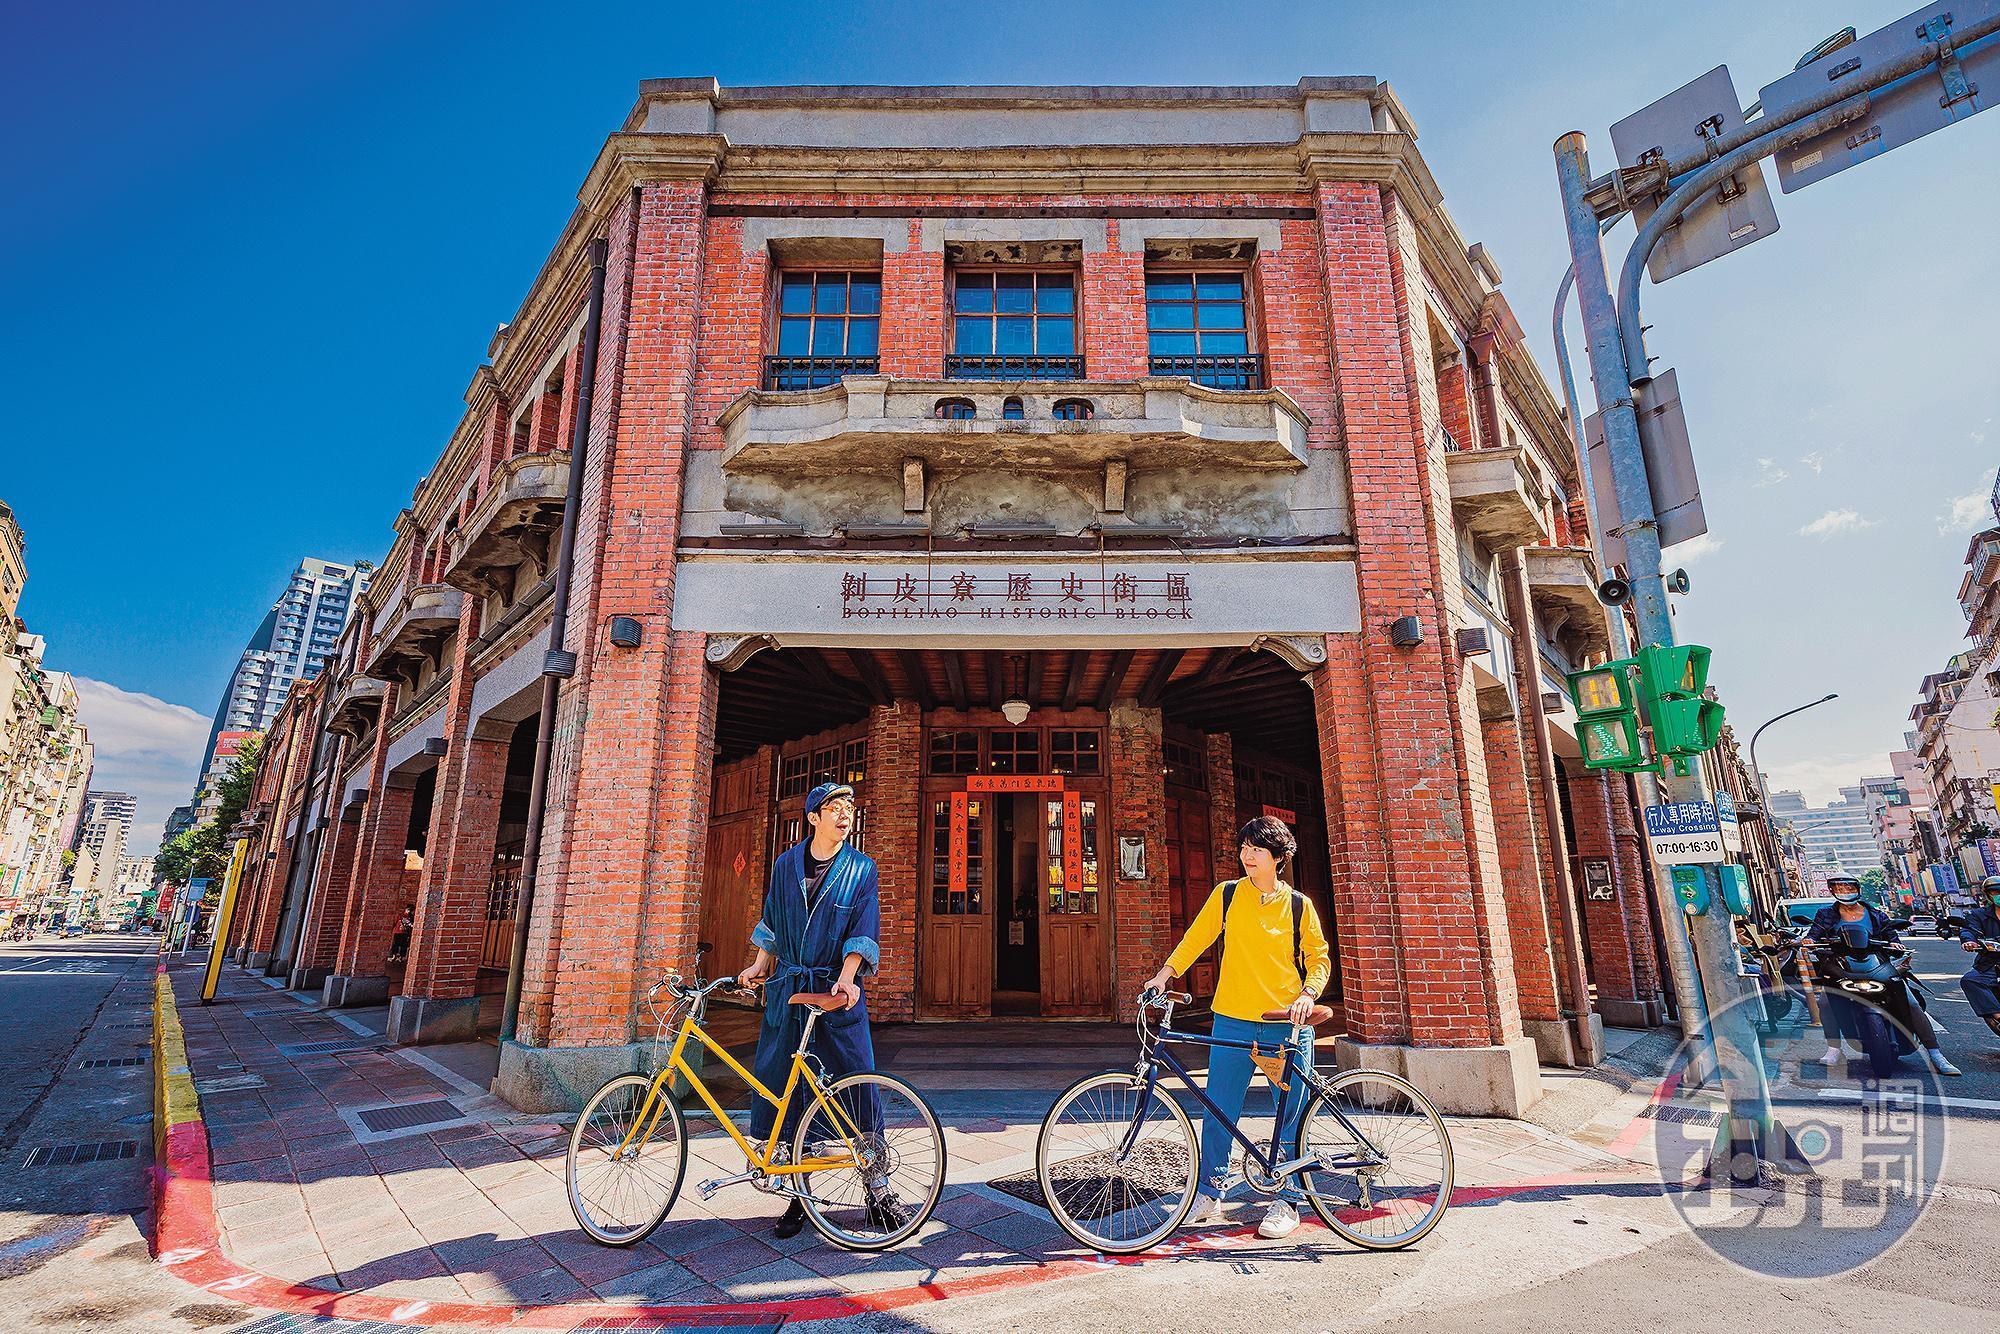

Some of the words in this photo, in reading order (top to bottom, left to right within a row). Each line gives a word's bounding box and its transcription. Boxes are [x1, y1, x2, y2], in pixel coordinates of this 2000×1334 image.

[840, 571, 1193, 603] 剝皮寮歷史街區
[841, 607, 958, 619] BOPILIAO
[980, 607, 1096, 619] HISTORIC
[1115, 607, 1193, 619] BLOCK
[1646, 801, 1715, 827] 行人專用時相
[1650, 826, 1676, 834] 4-way
[1679, 823, 1717, 832] Crossing
[1656, 840, 1719, 855] 07:00-16:30
